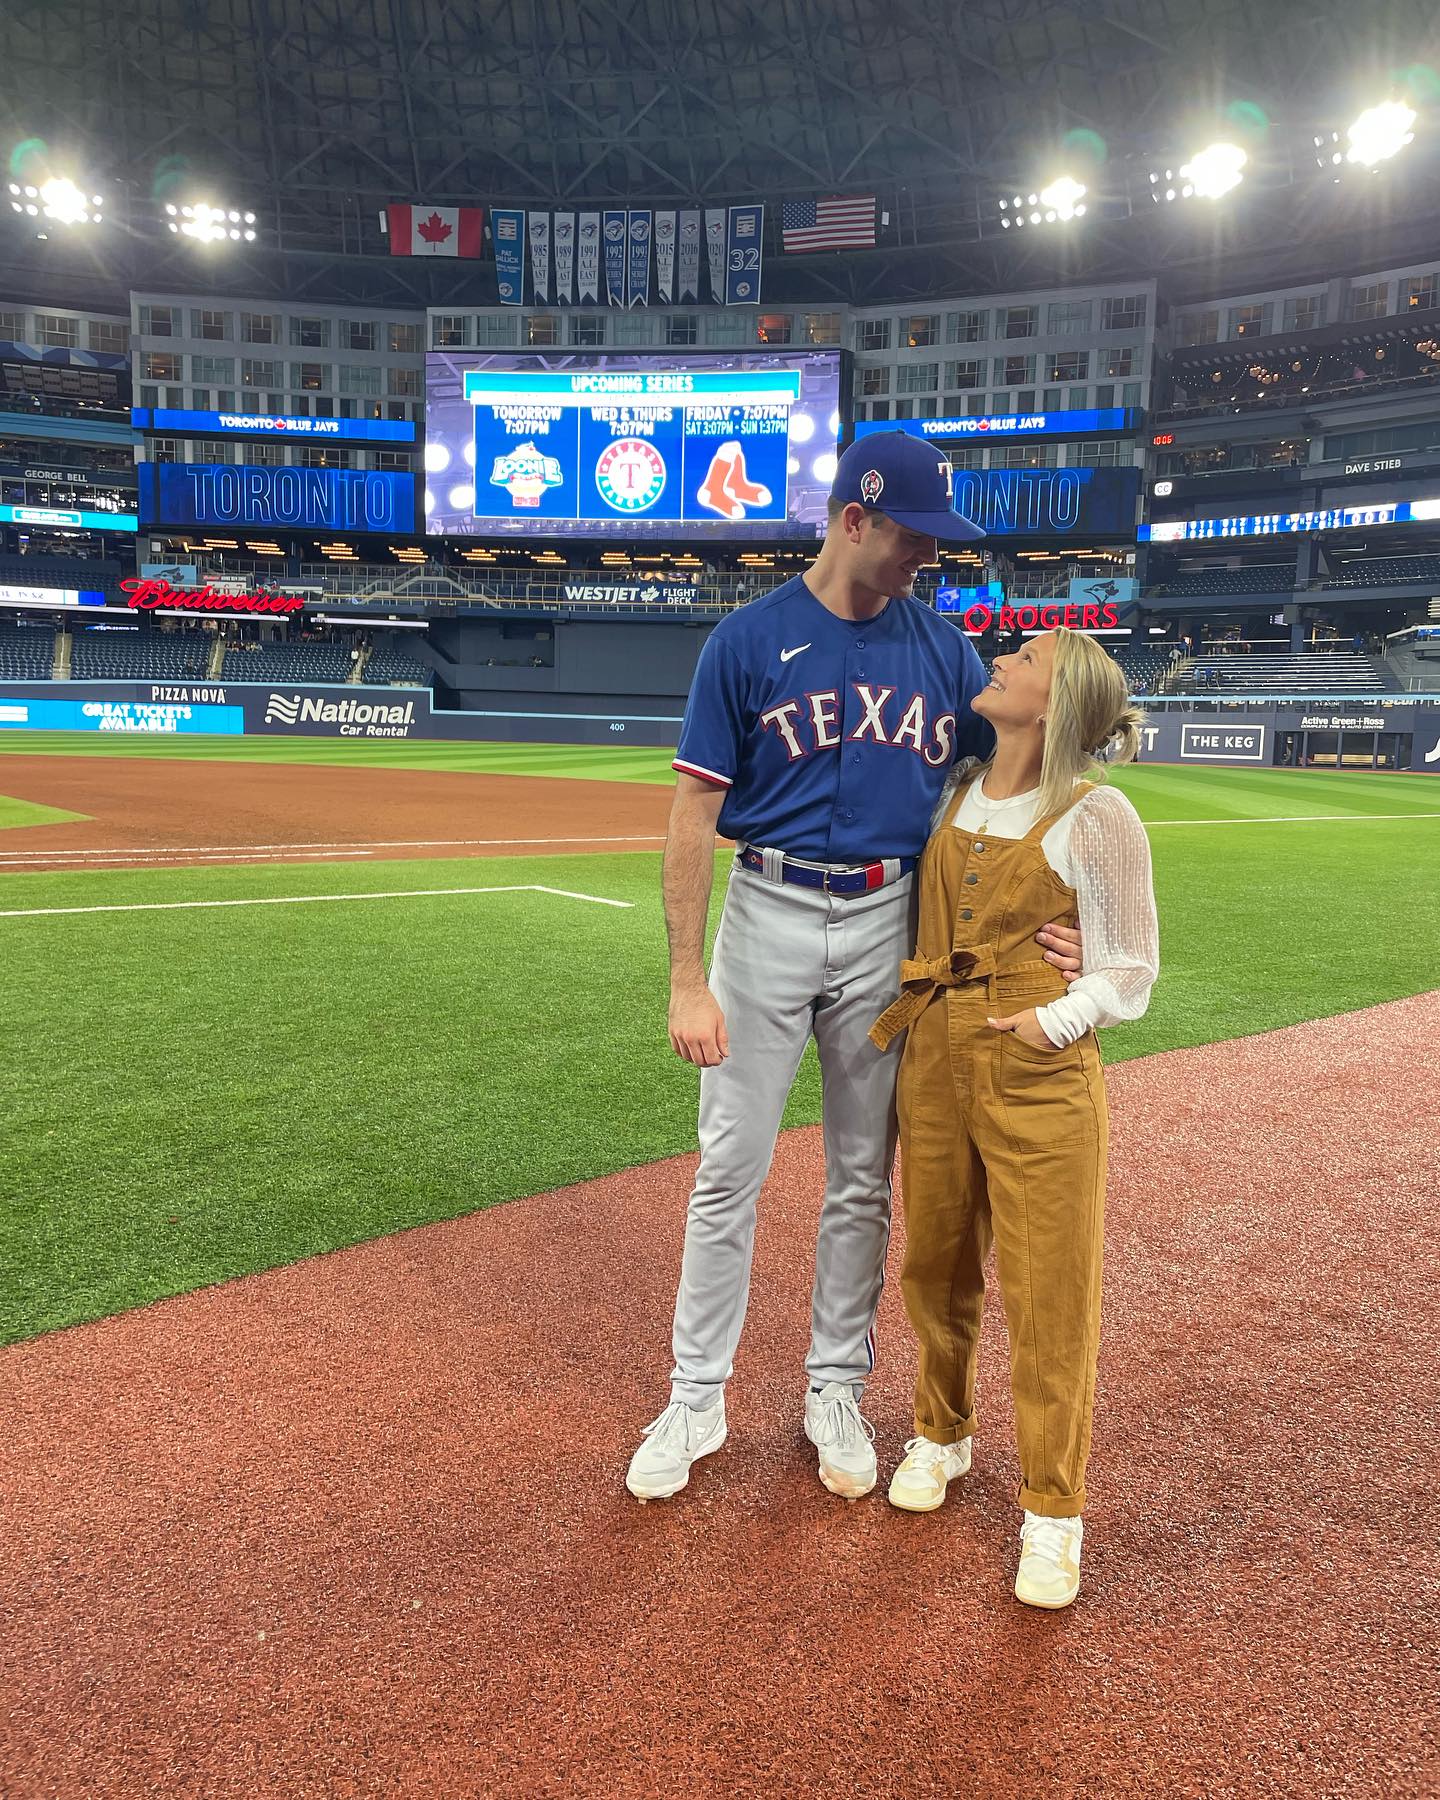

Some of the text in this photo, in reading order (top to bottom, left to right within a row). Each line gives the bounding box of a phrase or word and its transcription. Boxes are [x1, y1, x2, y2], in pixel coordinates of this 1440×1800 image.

[556, 245, 572, 257] 1989
[581, 245, 597, 257] 1991
[606, 245, 622, 258] 1992
[681, 243, 698, 256] 2016
[709, 243, 724, 256] 020
[730, 248, 759, 271] 32
[535, 270, 546, 280] AST
[560, 271, 570, 280] AST
[571, 375, 693, 393] UPCOMING SERIES
[492, 405, 562, 421] TOMORROW
[591, 407, 673, 421] WED & THURS
[686, 405, 787, 420] FRIDAY 7:07PM
[219, 416, 339, 433] TORONTO BLUE JAYS
[504, 420, 549, 435] 7:07PM
[609, 421, 654, 436] 7:07PM
[685, 420, 787, 435] SAT 3:07PM SUN 1:37PM
[922, 416, 1045, 434] TORONTO BLUE JAYS
[1345, 459, 1401, 475] DAVE STIEB
[25, 469, 88, 483] GEORGE BELL
[620, 463, 641, 488] T
[937, 462, 953, 497] T
[187, 466, 394, 527] TORONTO
[1157, 484, 1169, 494] CC
[120, 577, 305, 613] Budweiser
[564, 586, 697, 604] WESTJET FLIGHT
[667, 596, 692, 605] DECK
[1000, 603, 1119, 630] ROGERS
[152, 686, 226, 704] PIZZA NOVA
[82, 703, 192, 720] GREAT TICKETS
[98, 718, 177, 732] AVAILABLE!
[609, 723, 625, 731] 400
[761, 683, 957, 769] TEXAS
[1301, 716, 1329, 725] Active
[340, 724, 408, 737] Car Rental
[1190, 735, 1254, 749] THE KEG
